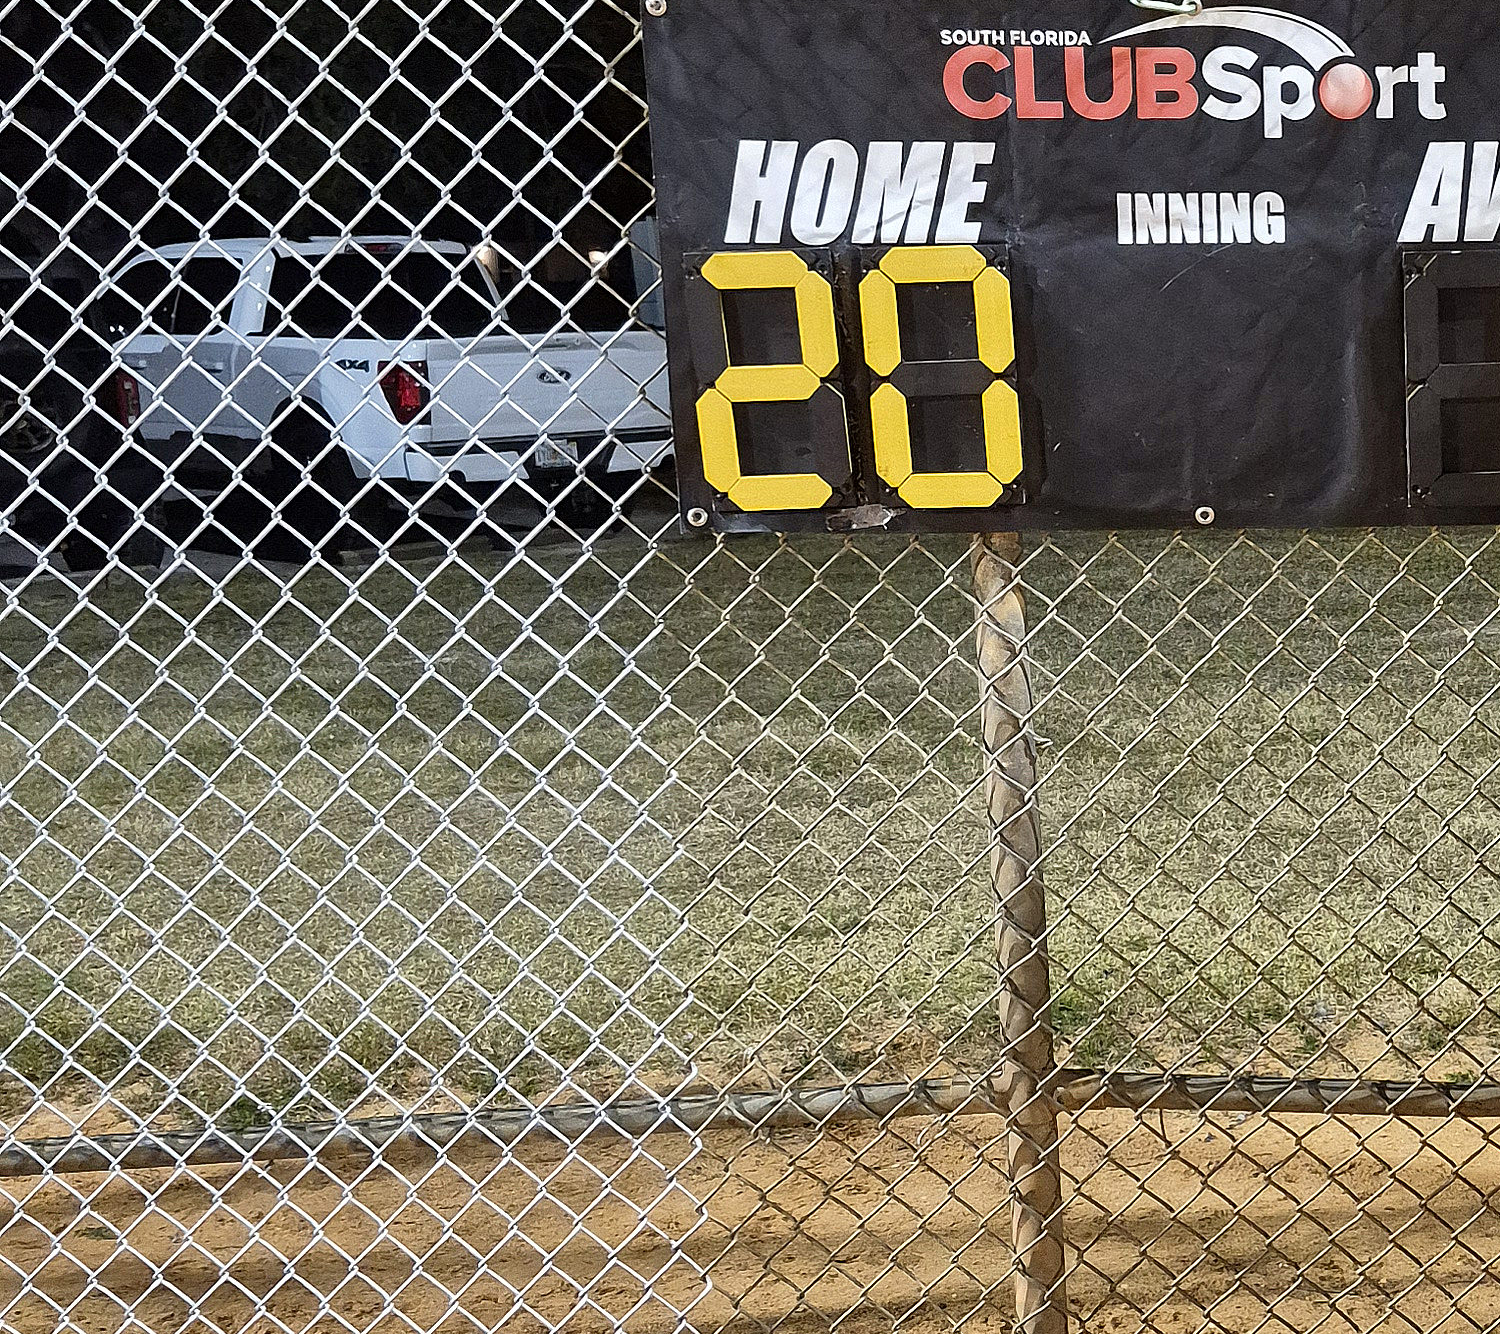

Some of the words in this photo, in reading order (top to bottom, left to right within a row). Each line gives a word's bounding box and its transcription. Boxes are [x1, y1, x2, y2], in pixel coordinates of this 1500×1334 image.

[939, 29, 1005, 47] SOUTH
[1009, 29, 1093, 47] FLORIDA
[724, 139, 997, 246] HOME
[1115, 190, 1287, 245] INNING
[695, 244, 1024, 511] 20
